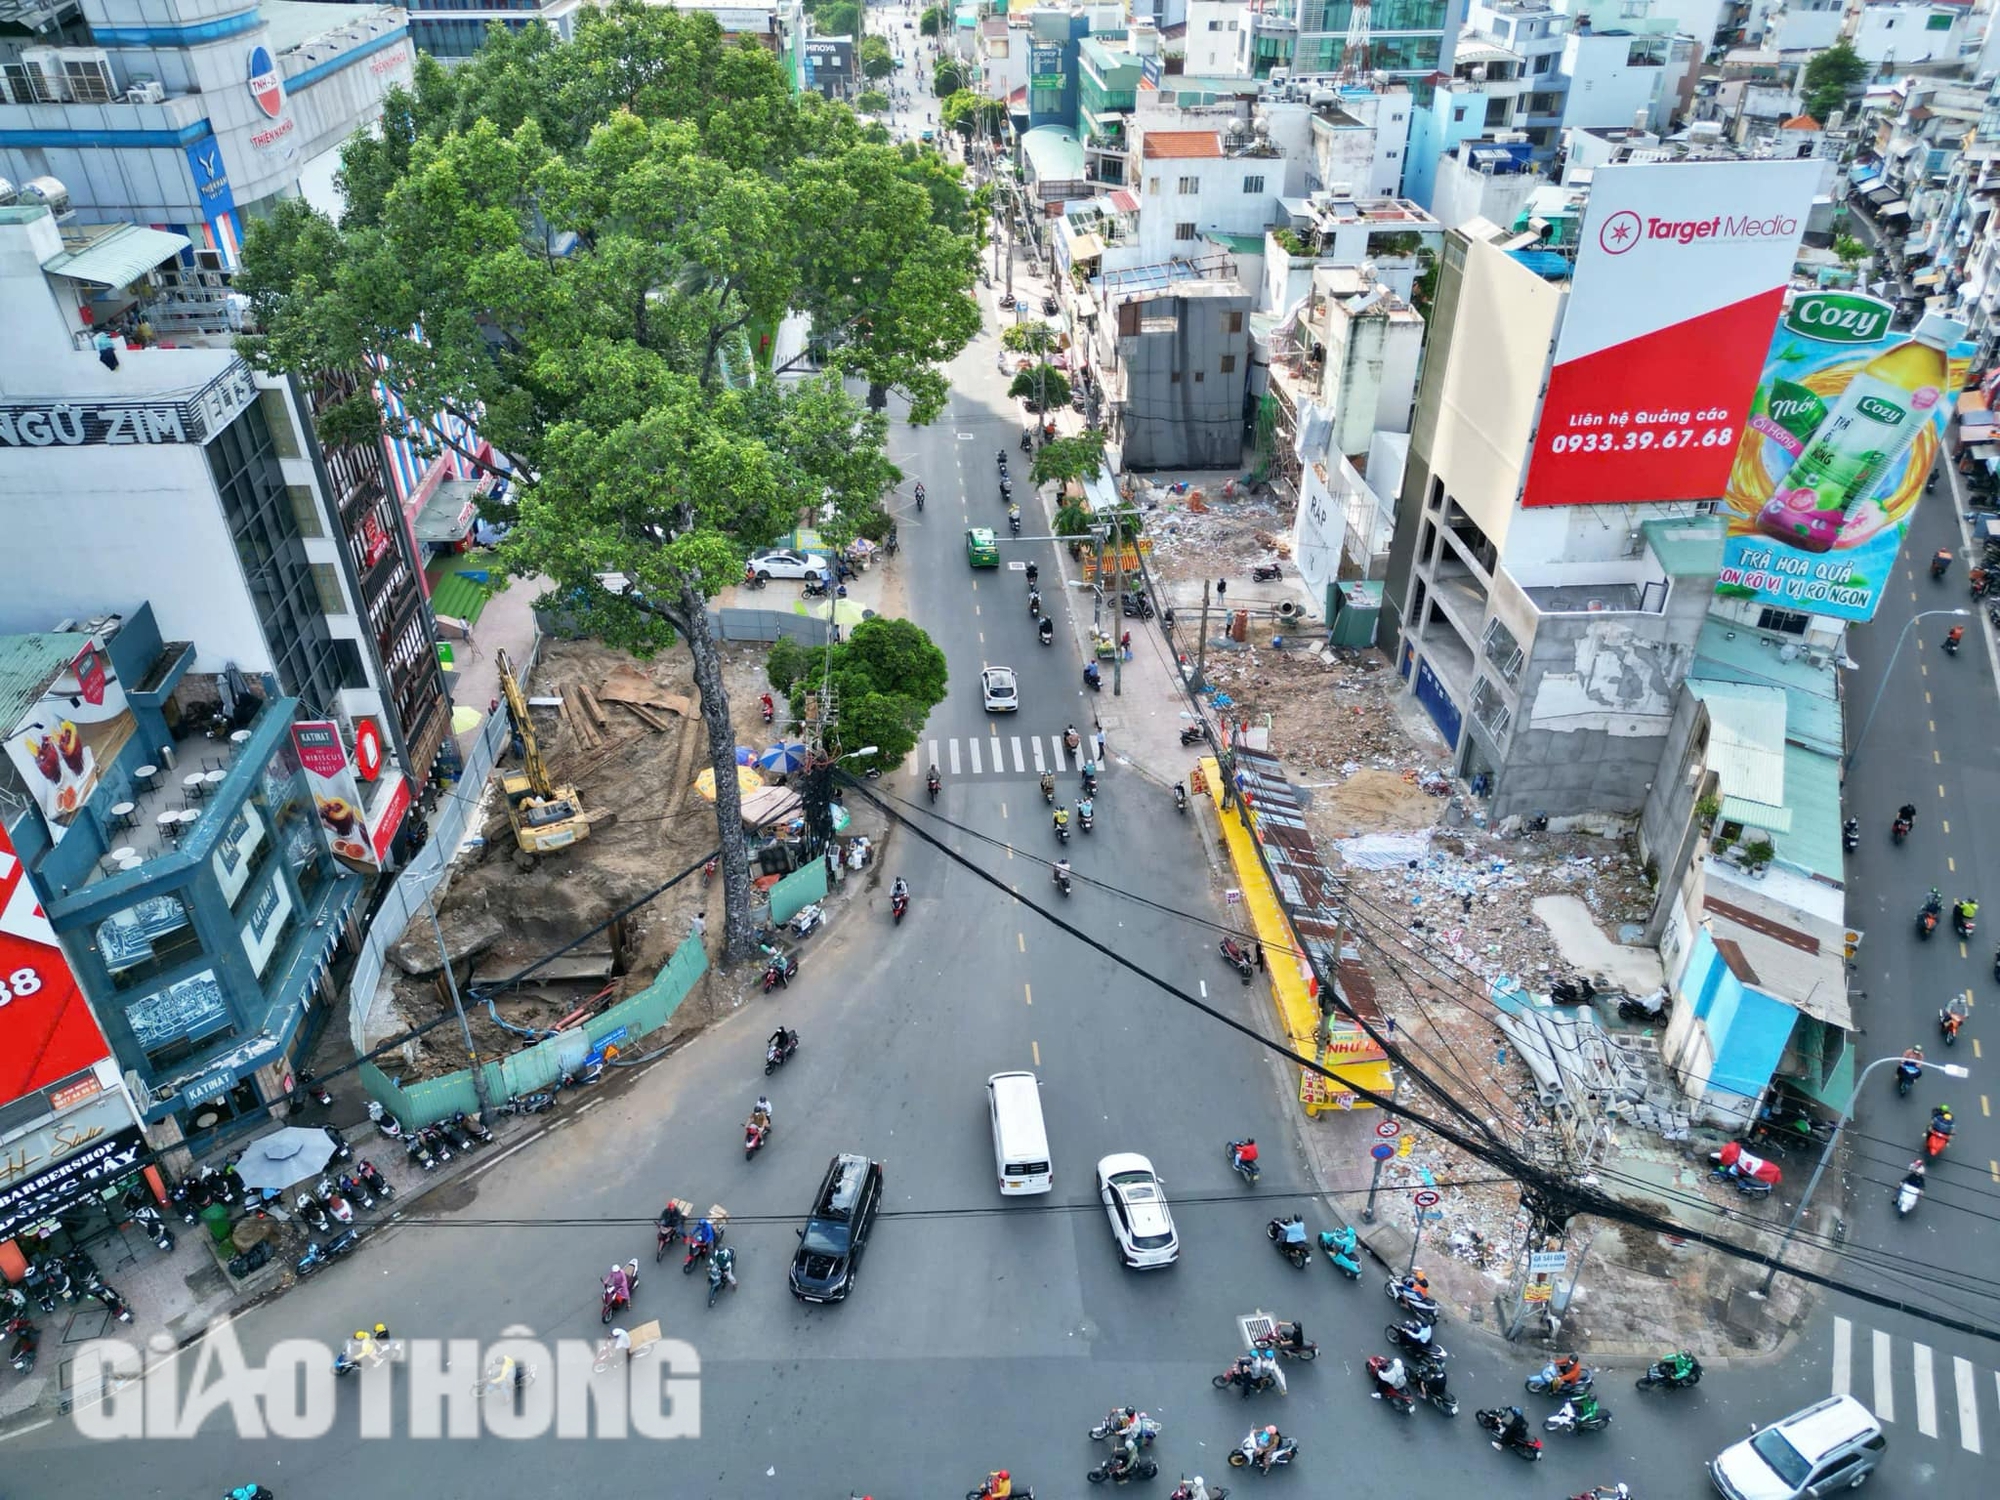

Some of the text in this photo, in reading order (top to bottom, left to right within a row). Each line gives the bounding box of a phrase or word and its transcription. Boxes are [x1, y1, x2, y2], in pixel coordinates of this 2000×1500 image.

[1648, 214, 1797, 244] Target Media
[1799, 299, 1880, 337] Cozy
[199, 368, 251, 439] IELTS
[1569, 407, 1728, 428] Liên hệ Quảng cáo
[1862, 399, 1900, 422] Cozy
[98, 408, 186, 444] ZIM
[1551, 427, 1733, 453] 0933.39.67.68
[1739, 548, 1854, 584] TRÀ HOA QUẢ
[1743, 572, 1764, 588] RÕ
[1766, 577, 1782, 594] VỊ
[1787, 579, 1804, 599] VỊ
[1805, 582, 1828, 599] RÕ
[1828, 586, 1870, 608] NGON
[301, 732, 330, 742] KATINAT
[189, 1072, 230, 1101] KATINAT
[0, 1141, 117, 1209] BARBERSHOP
[83, 1146, 138, 1180] TÂY
